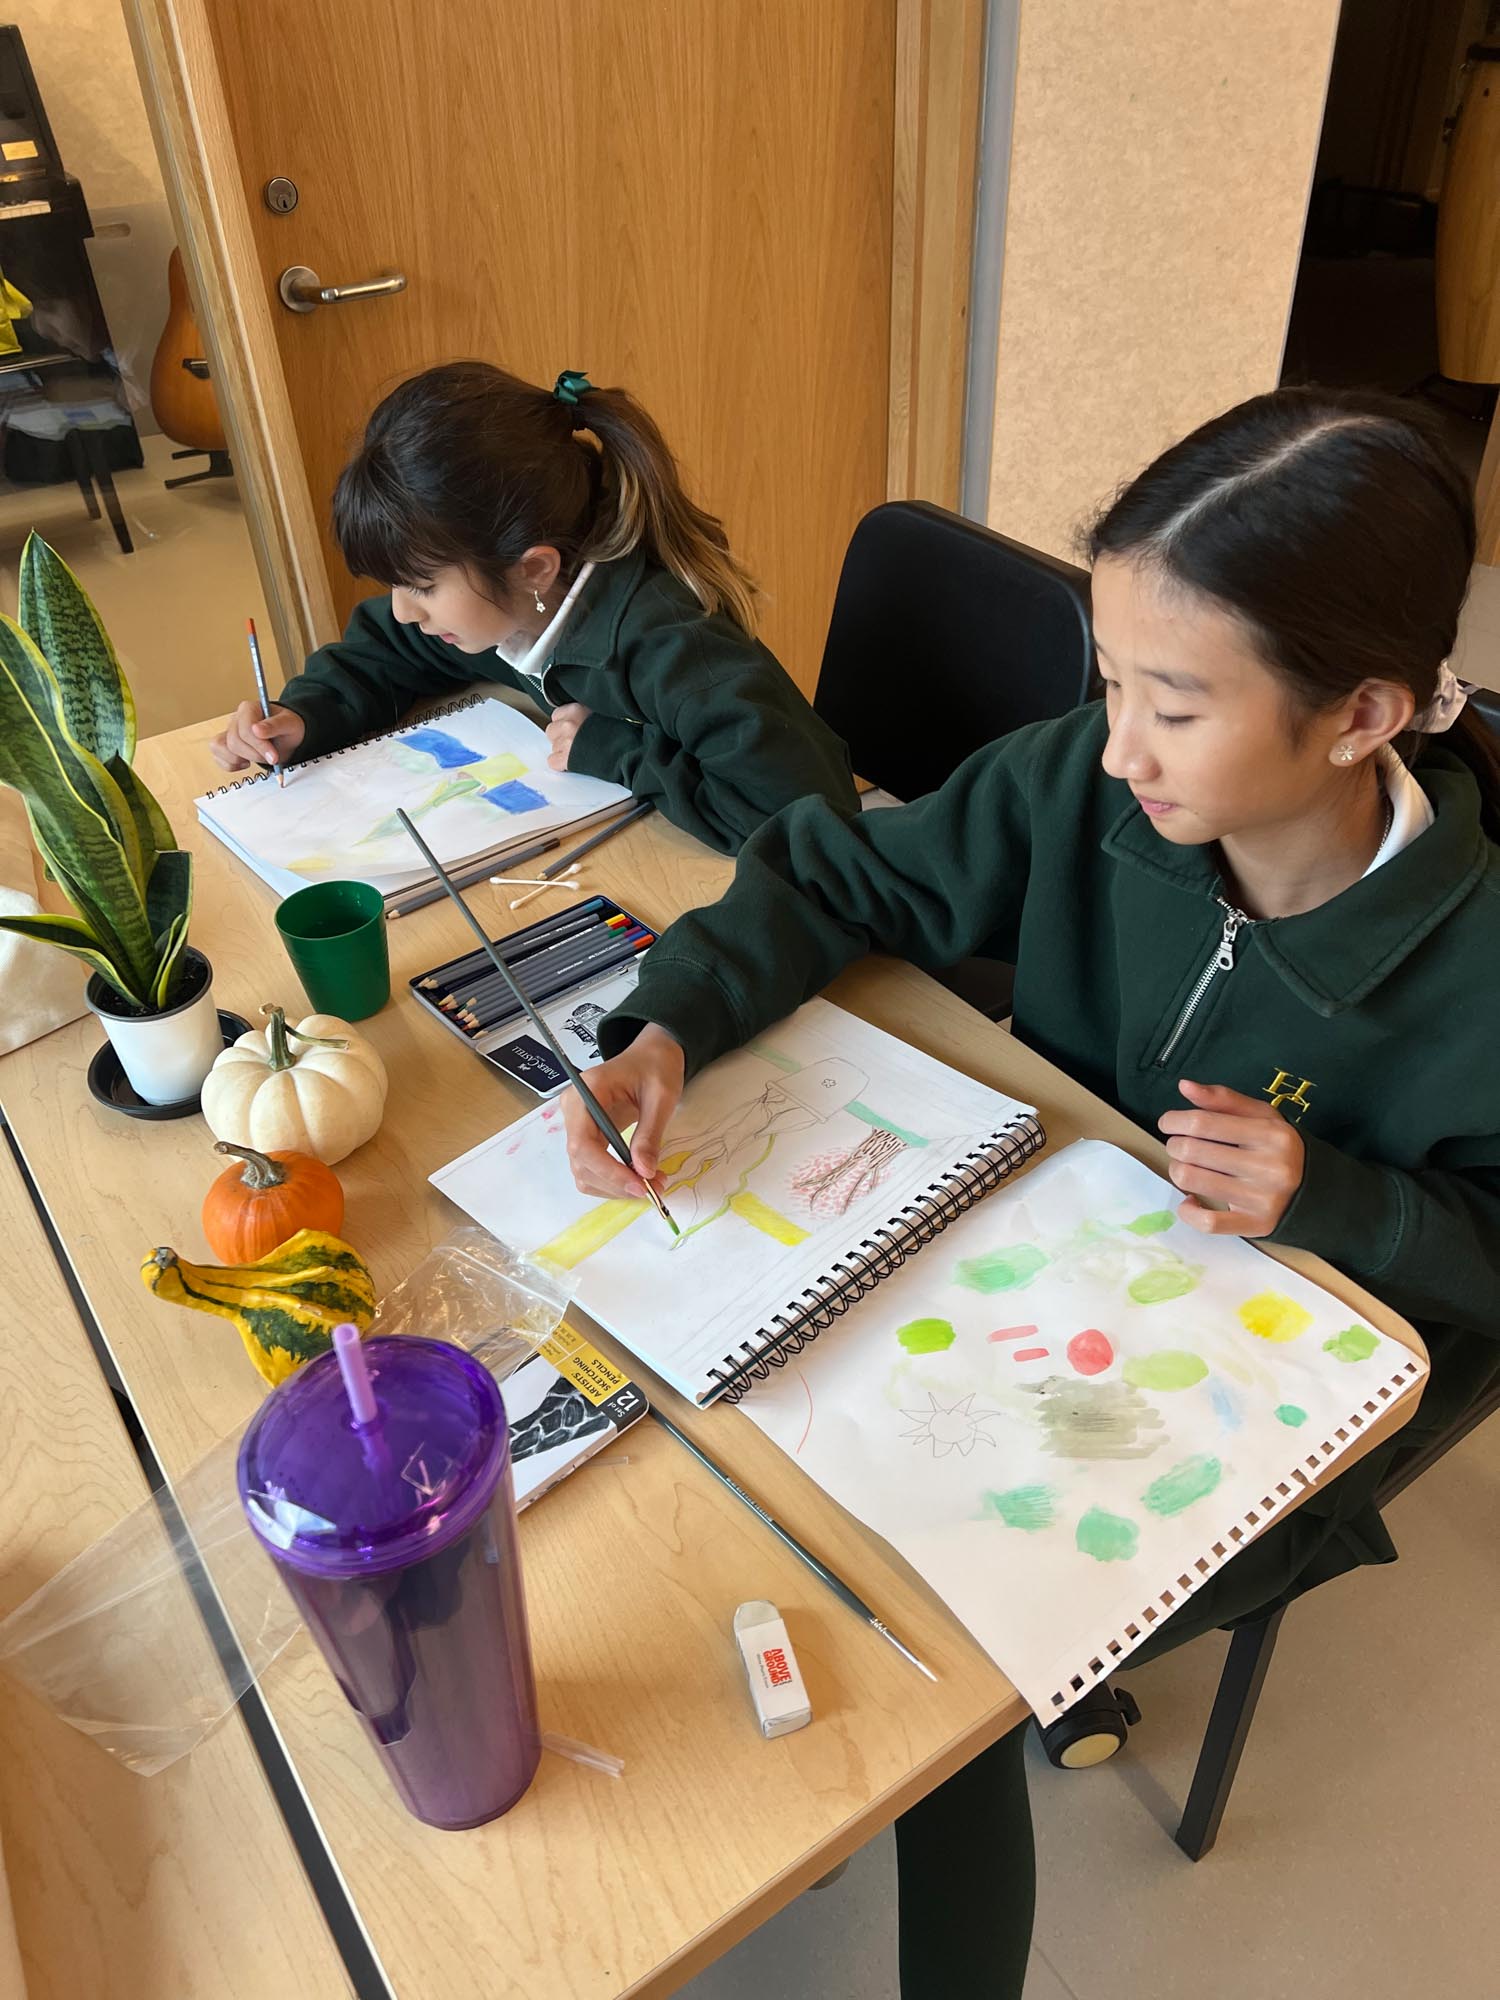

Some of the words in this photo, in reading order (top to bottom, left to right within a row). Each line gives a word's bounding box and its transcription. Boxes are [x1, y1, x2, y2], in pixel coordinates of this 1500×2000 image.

[573, 1357, 611, 1392] SKETCHING
[591, 1359, 620, 1385] PENCILS
[614, 1405, 626, 1418] Set
[616, 1390, 640, 1412] 12
[763, 1650, 781, 1684] GROUND
[771, 1648, 791, 1682] ABOVE
